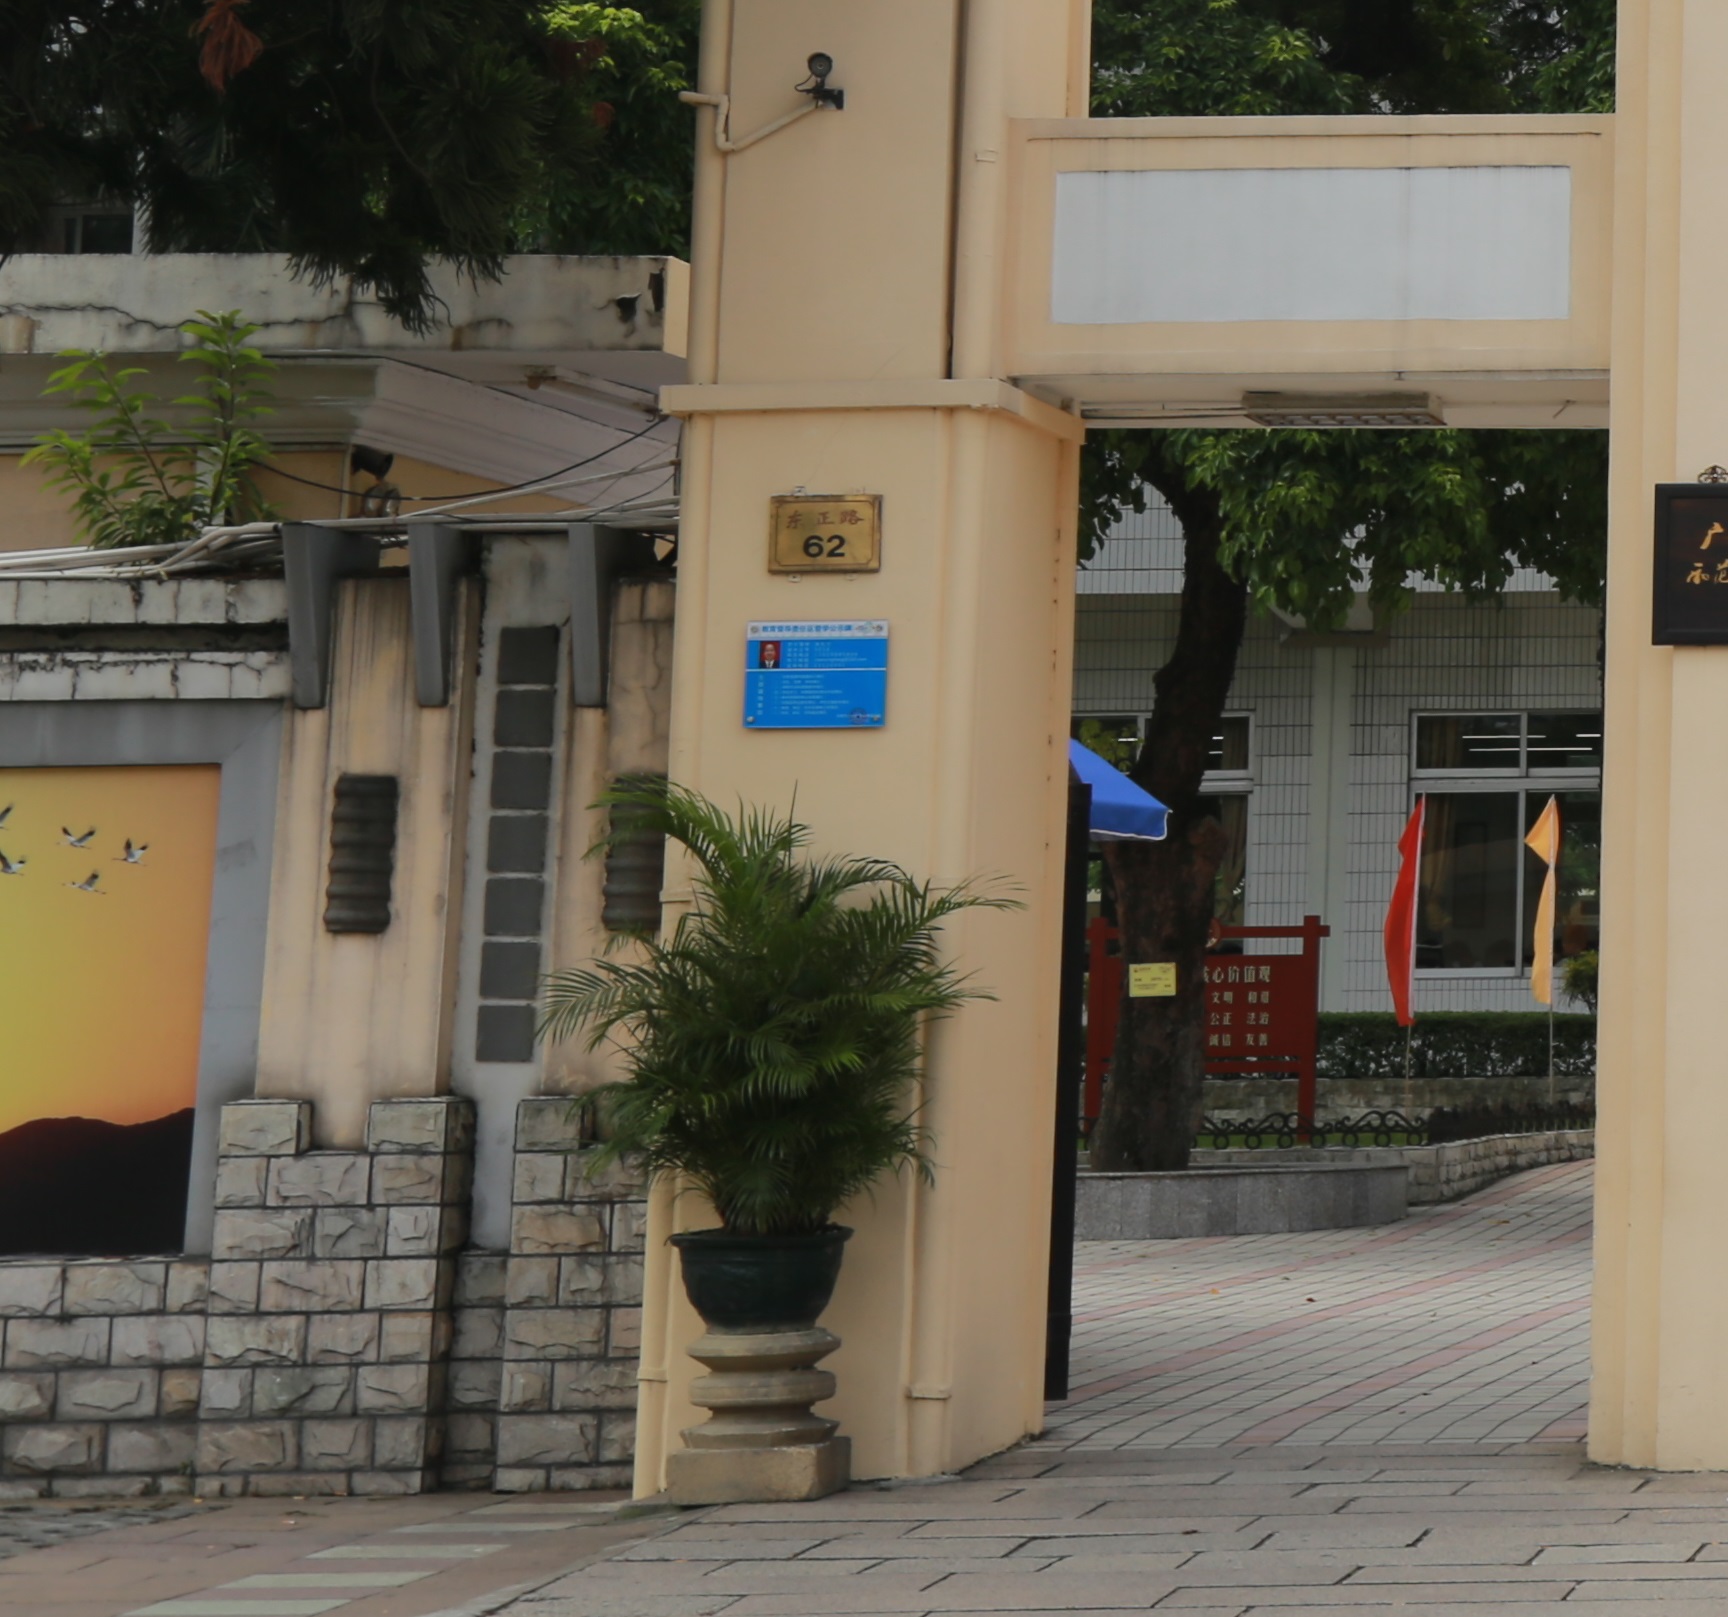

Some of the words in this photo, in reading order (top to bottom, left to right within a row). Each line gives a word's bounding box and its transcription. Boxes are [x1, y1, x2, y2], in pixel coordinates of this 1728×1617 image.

[785, 509, 865, 530] 东正路
[802, 534, 846, 558] 62
